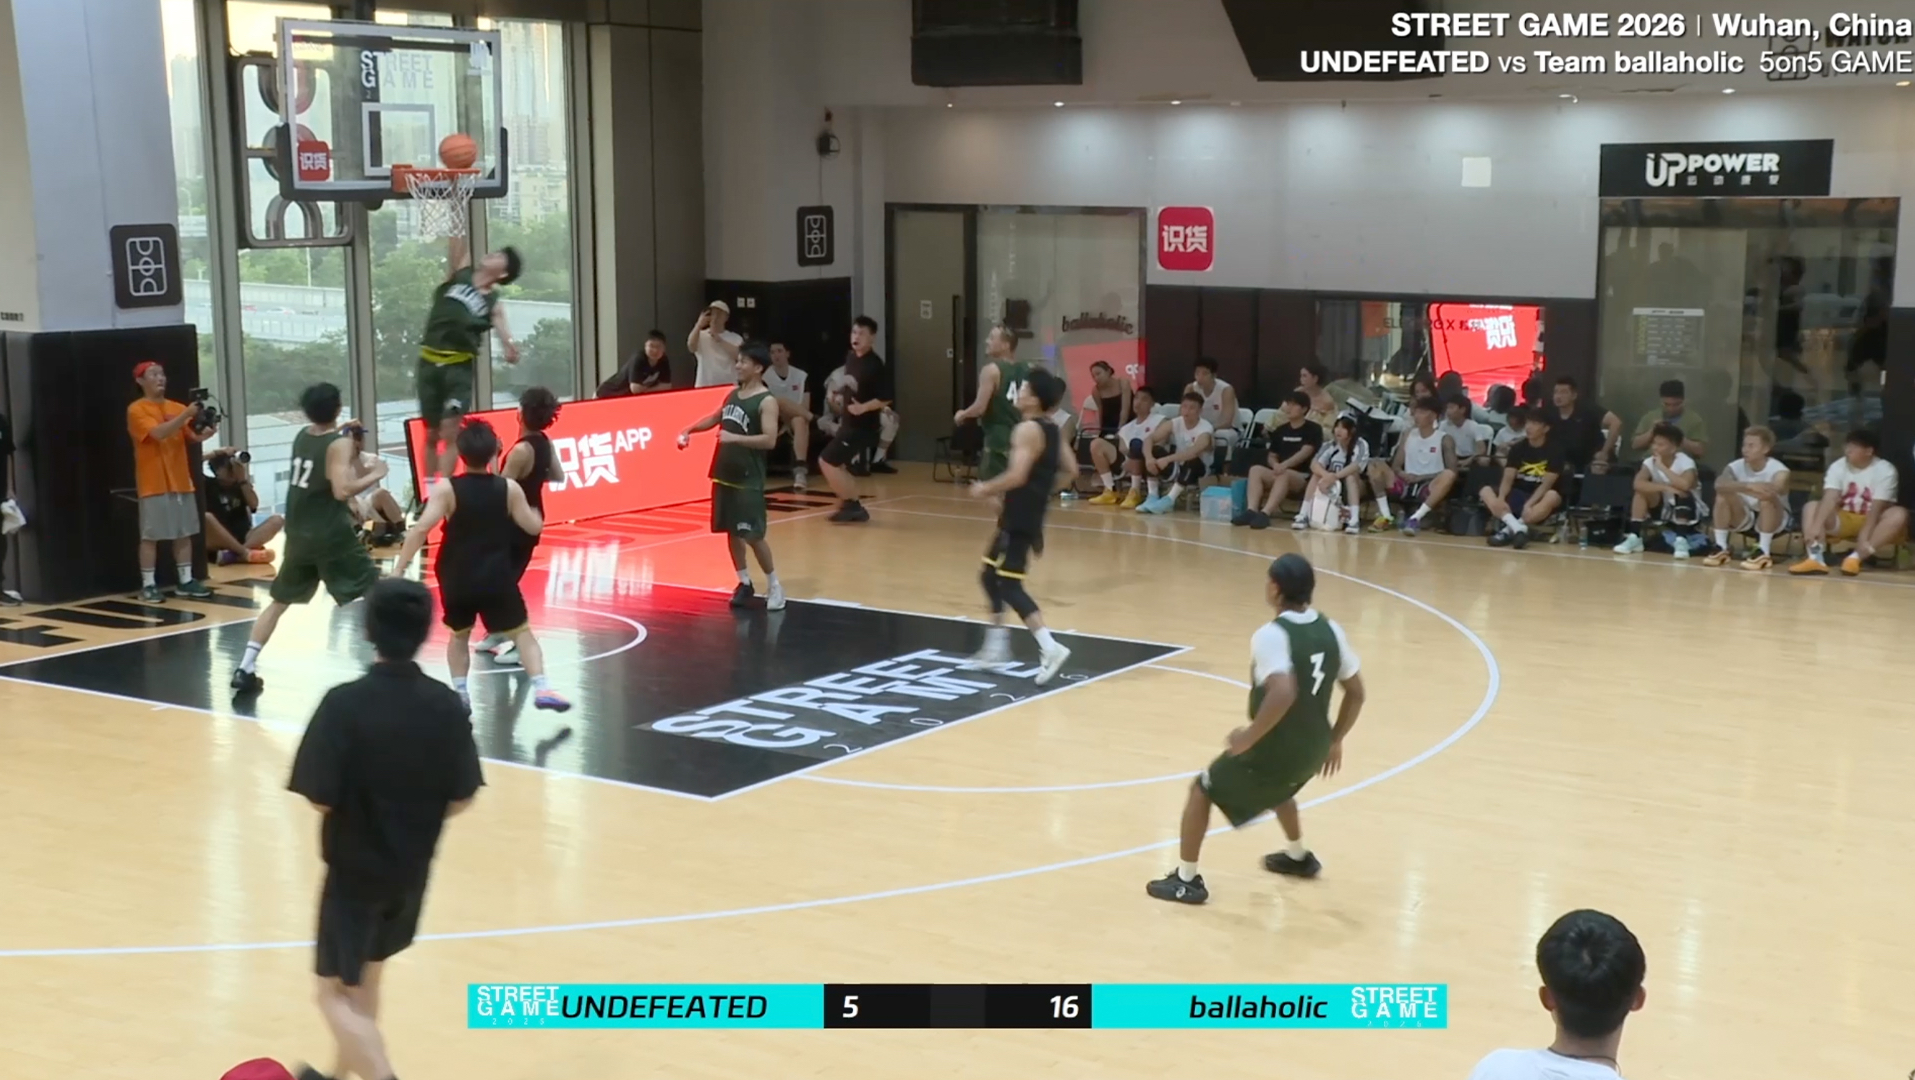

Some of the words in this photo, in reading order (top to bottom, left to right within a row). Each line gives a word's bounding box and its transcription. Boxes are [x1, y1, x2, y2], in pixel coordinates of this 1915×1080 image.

[1162, 225, 1208, 252] 识货
[615, 427, 652, 453] APP
[291, 457, 313, 489] 12
[1310, 652, 1325, 696] 3
[652, 649, 976, 738] STREET
